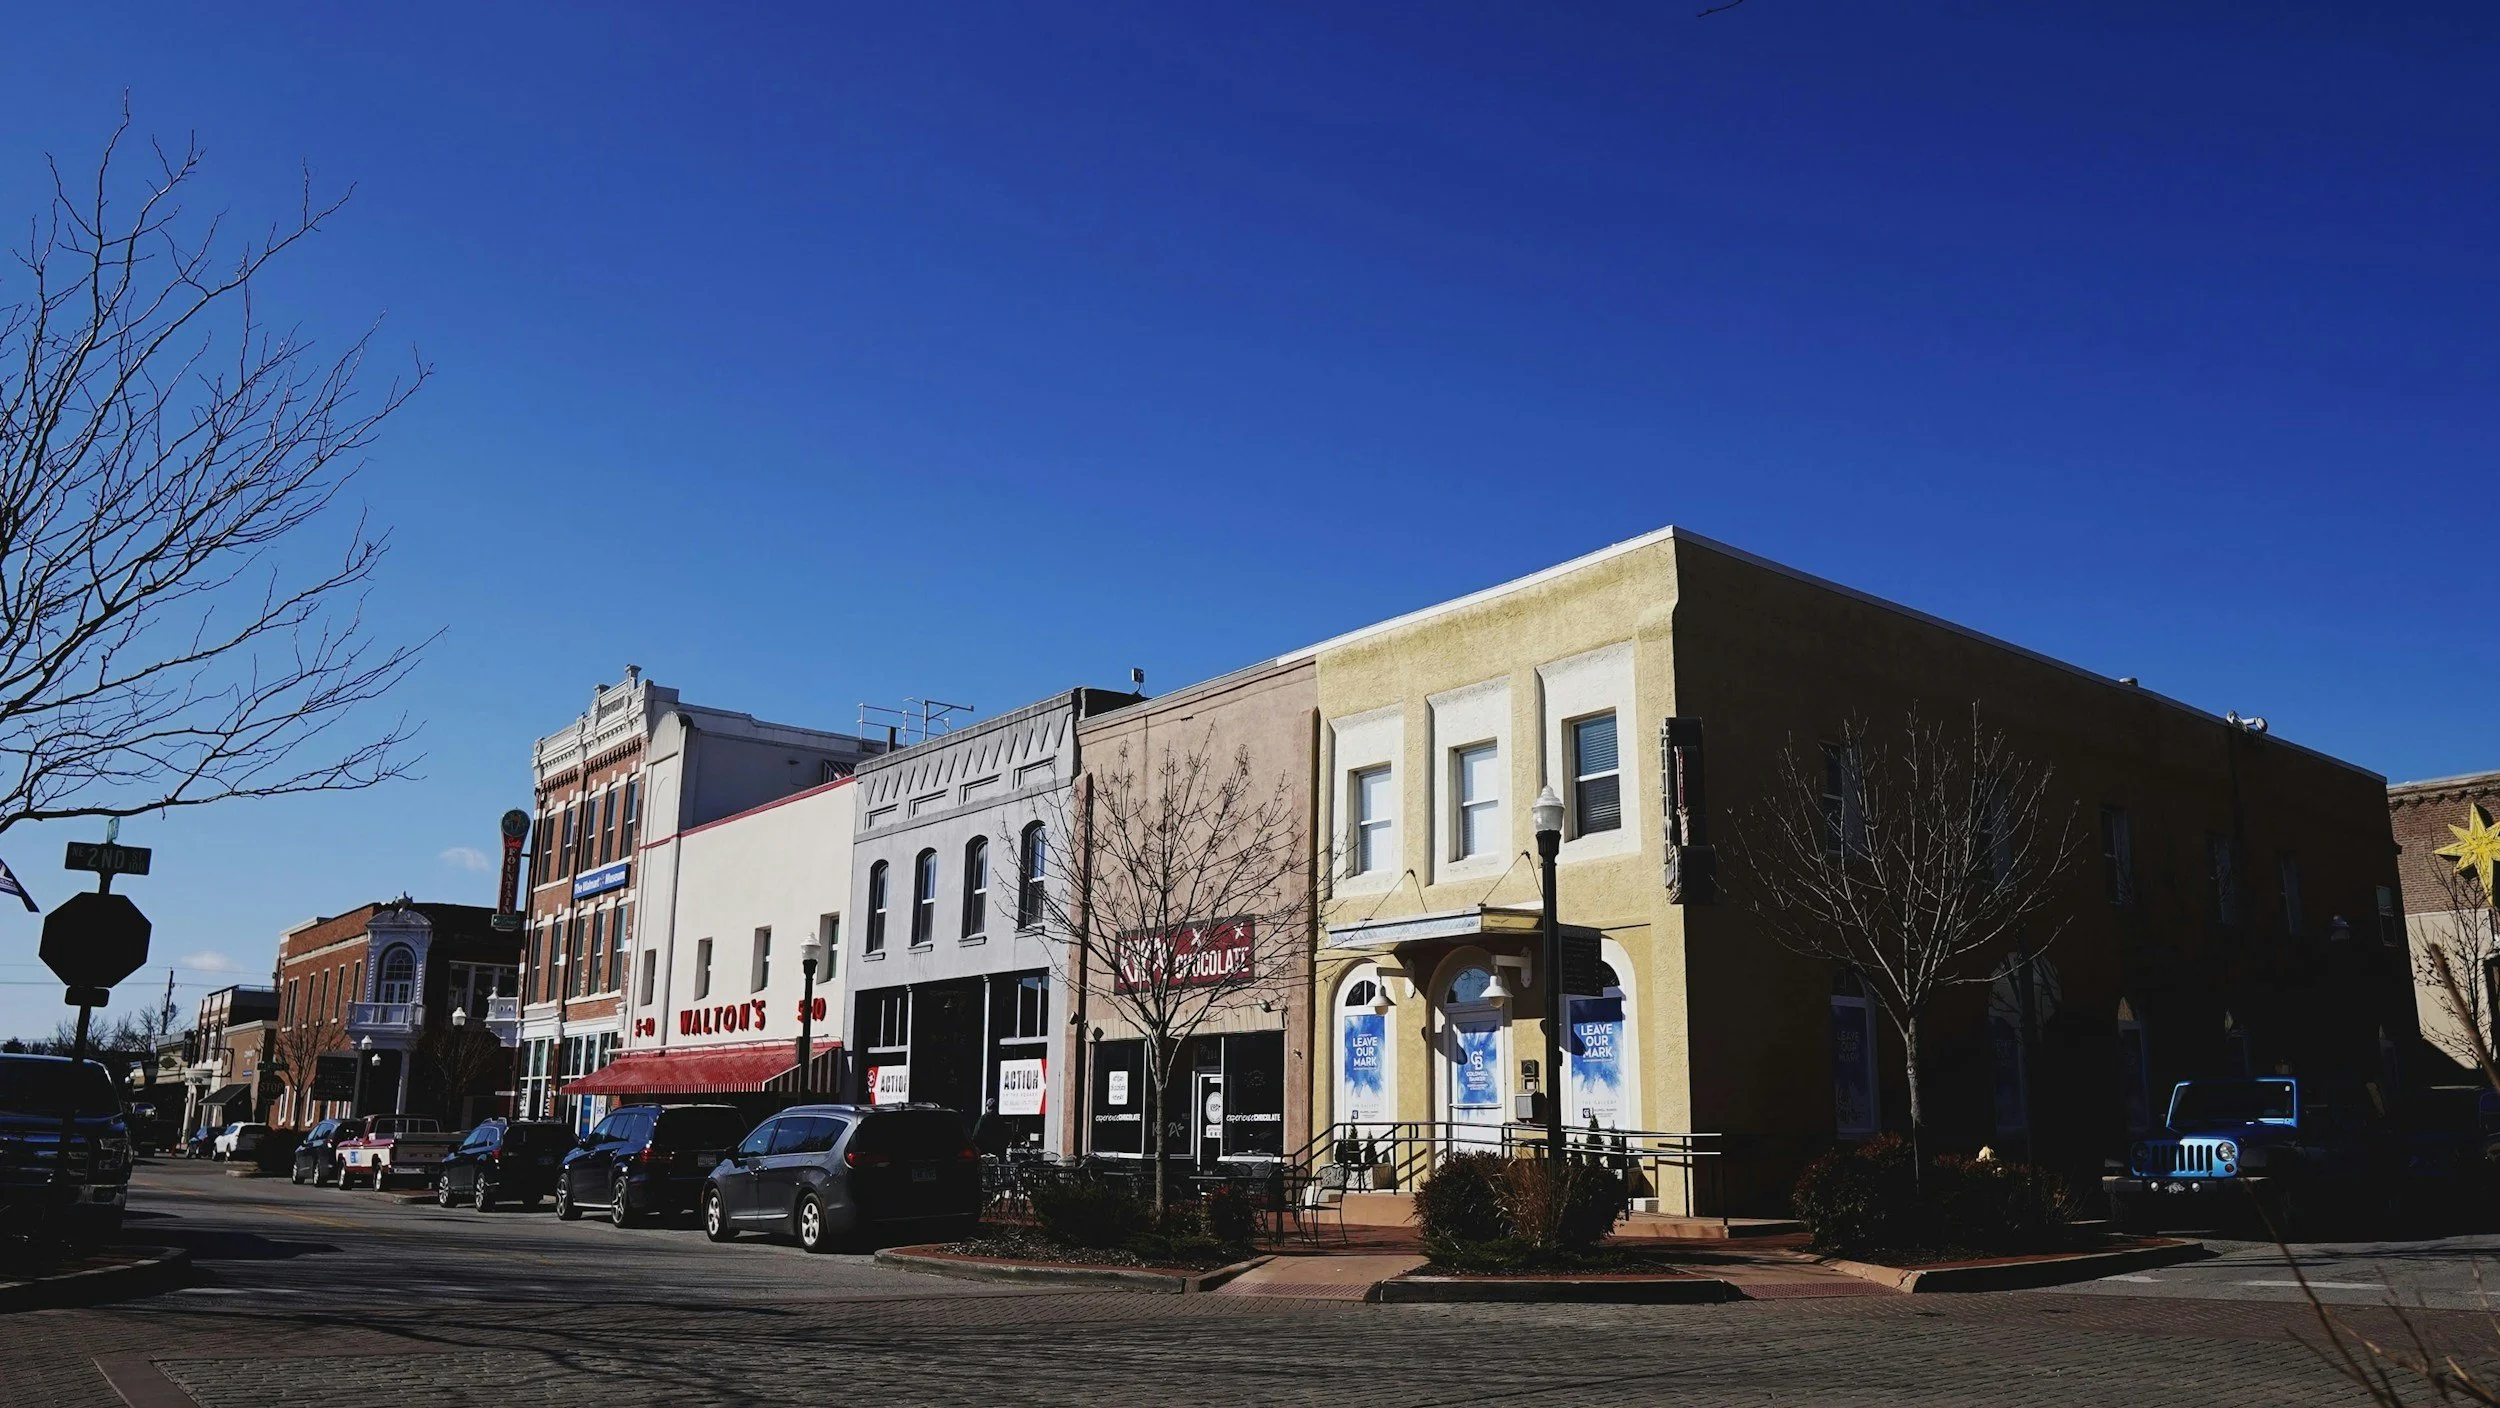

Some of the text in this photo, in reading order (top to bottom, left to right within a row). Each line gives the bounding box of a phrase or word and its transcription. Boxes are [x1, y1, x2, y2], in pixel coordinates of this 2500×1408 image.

[71, 847, 146, 870] NE 2ND ST
[503, 849, 517, 914] FOUNTAIN
[605, 870, 626, 885] Museum
[1174, 946, 1250, 980] CHOCOLATE
[680, 998, 766, 1036] WALTON'S
[1581, 1023, 1613, 1036] LEAVE
[1353, 1036, 1378, 1047] LEAVE
[1585, 1035, 1609, 1047] OUR
[1356, 1047, 1375, 1057] OUR
[1583, 1047, 1613, 1058] MARK
[1353, 1057, 1377, 1067] MARK
[1004, 1069, 1039, 1090] ACTION
